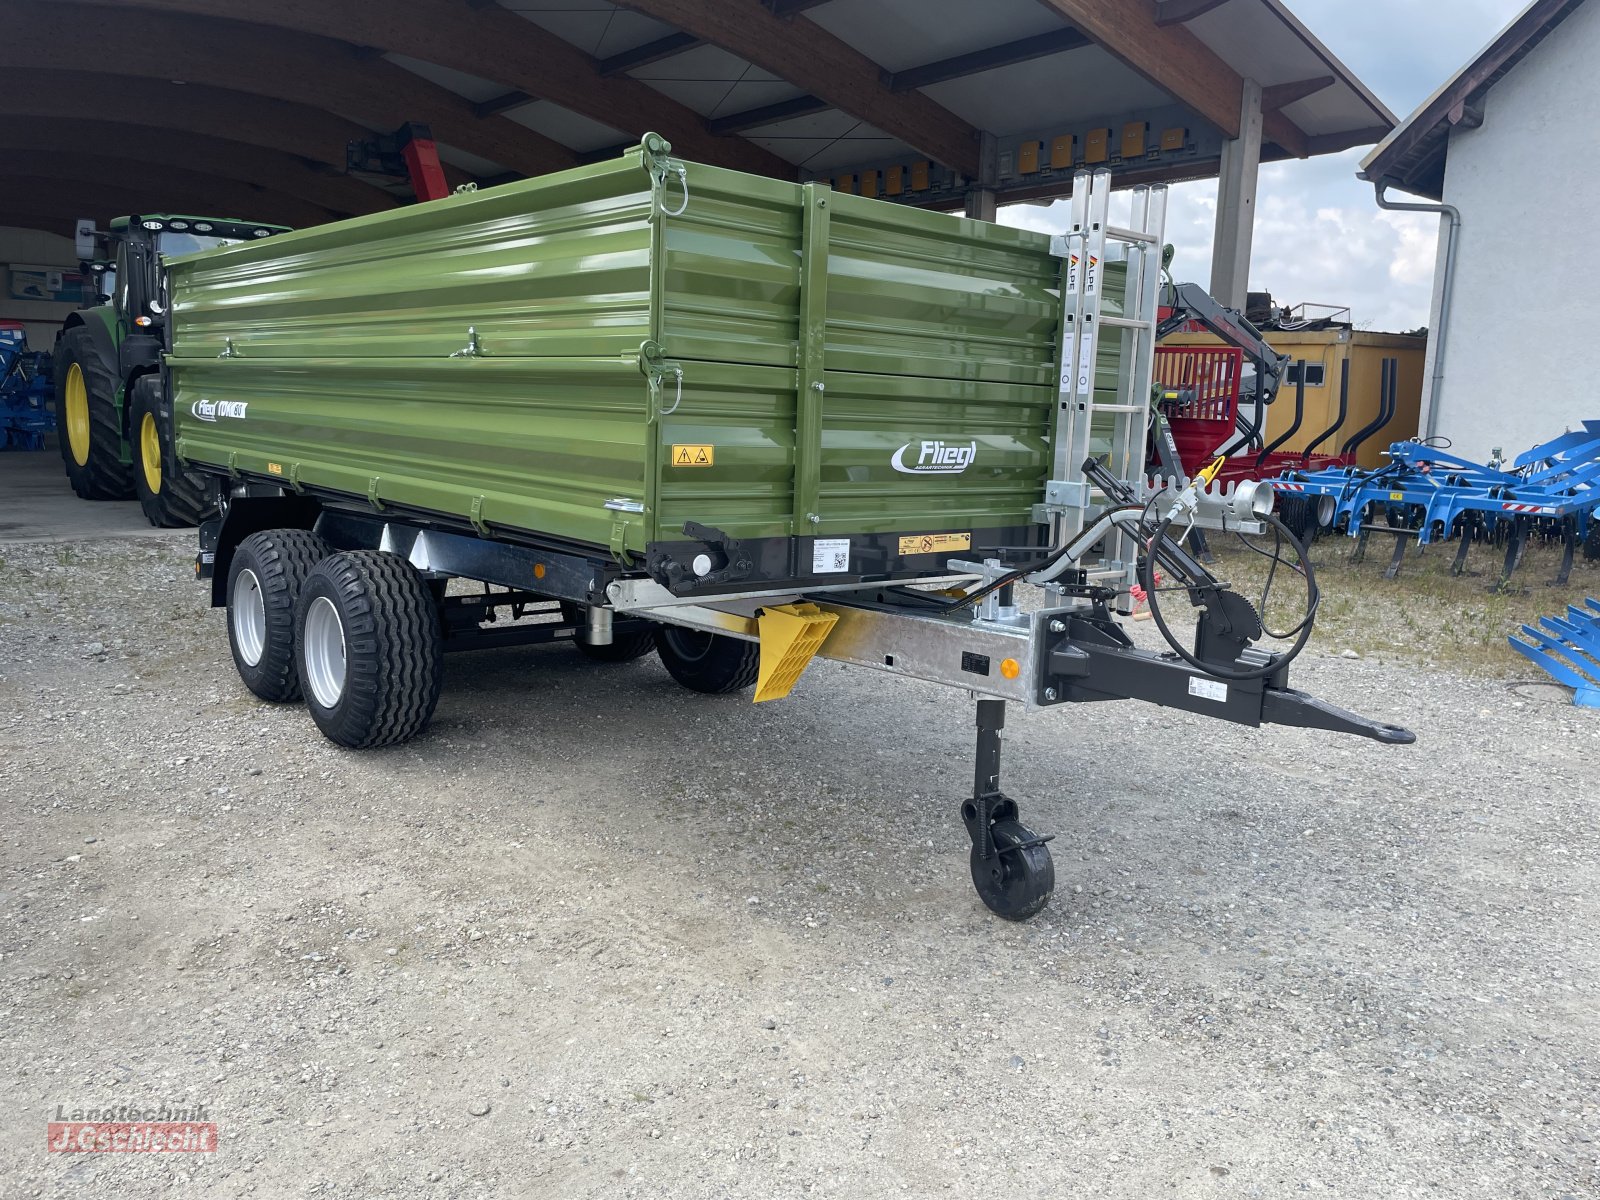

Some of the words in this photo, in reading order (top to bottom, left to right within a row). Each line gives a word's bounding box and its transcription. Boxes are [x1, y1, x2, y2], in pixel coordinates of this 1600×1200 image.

[1069, 257, 1077, 291] ALPE
[1088, 258, 1096, 292] ALPE
[918, 440, 977, 469] Fliegl
